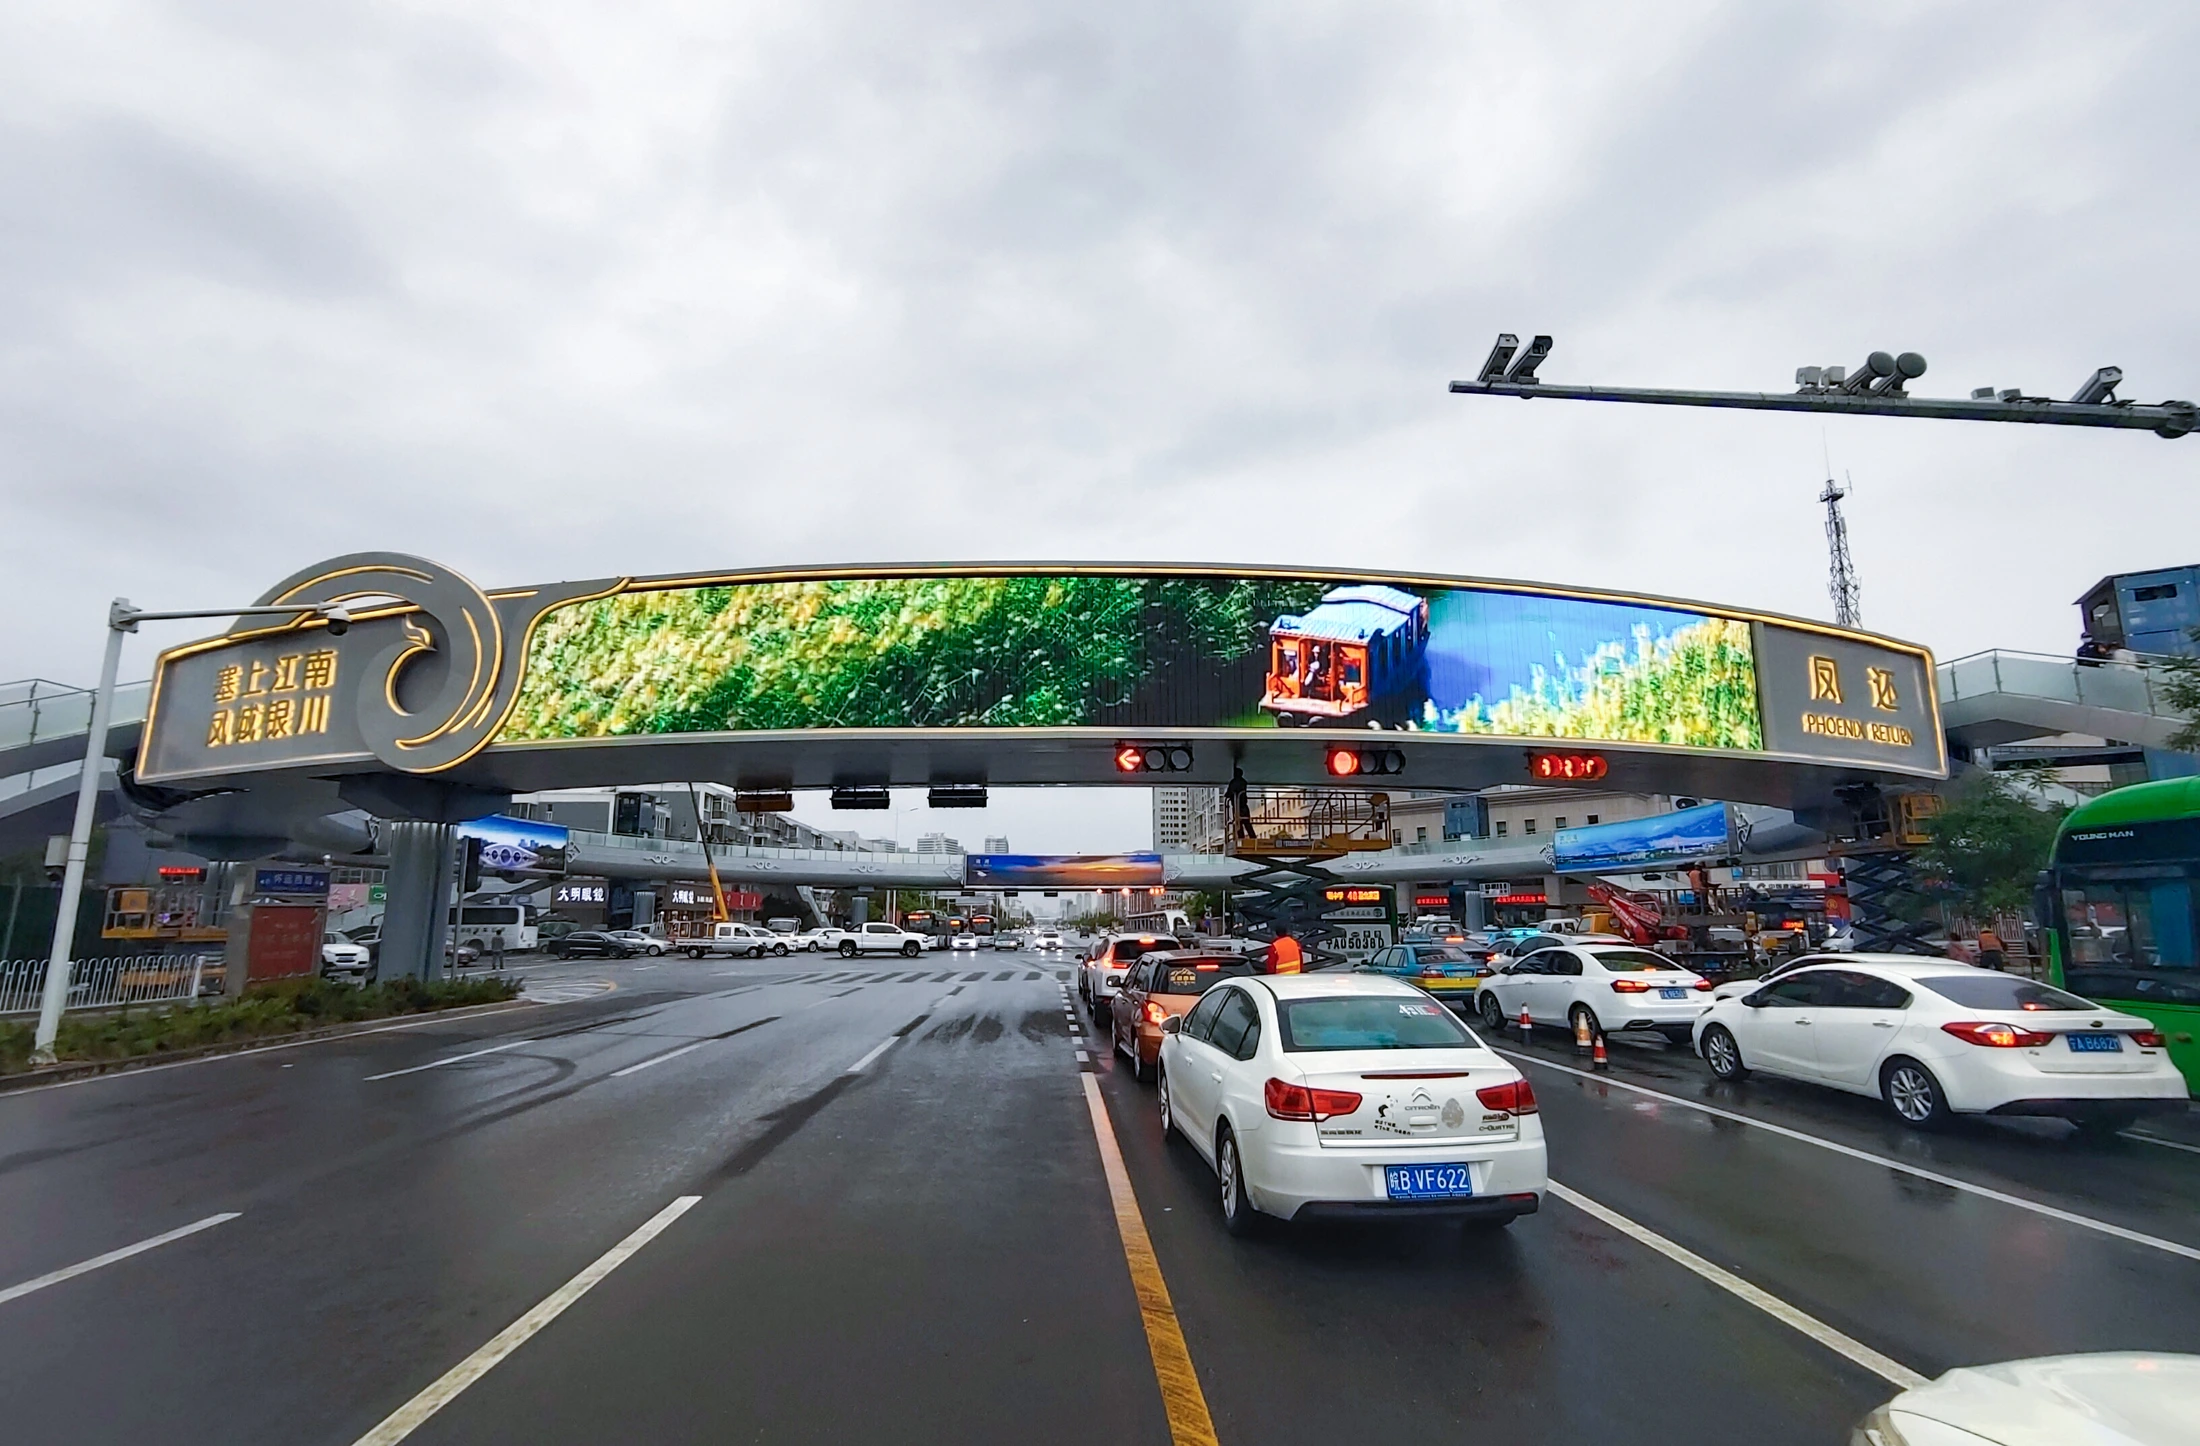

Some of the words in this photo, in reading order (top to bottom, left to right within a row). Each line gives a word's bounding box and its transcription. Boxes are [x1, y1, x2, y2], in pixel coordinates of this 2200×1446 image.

[213, 649, 337, 704] 塞上江南
[206, 695, 331, 748] 凤城银川
[1803, 714, 1866, 739] PHOENIX
[1868, 722, 1914, 746] RETURN
[2071, 832, 2107, 841] YOUNG
[2109, 830, 2134, 838] MAN
[557, 887, 605, 902] 大明眼镜
